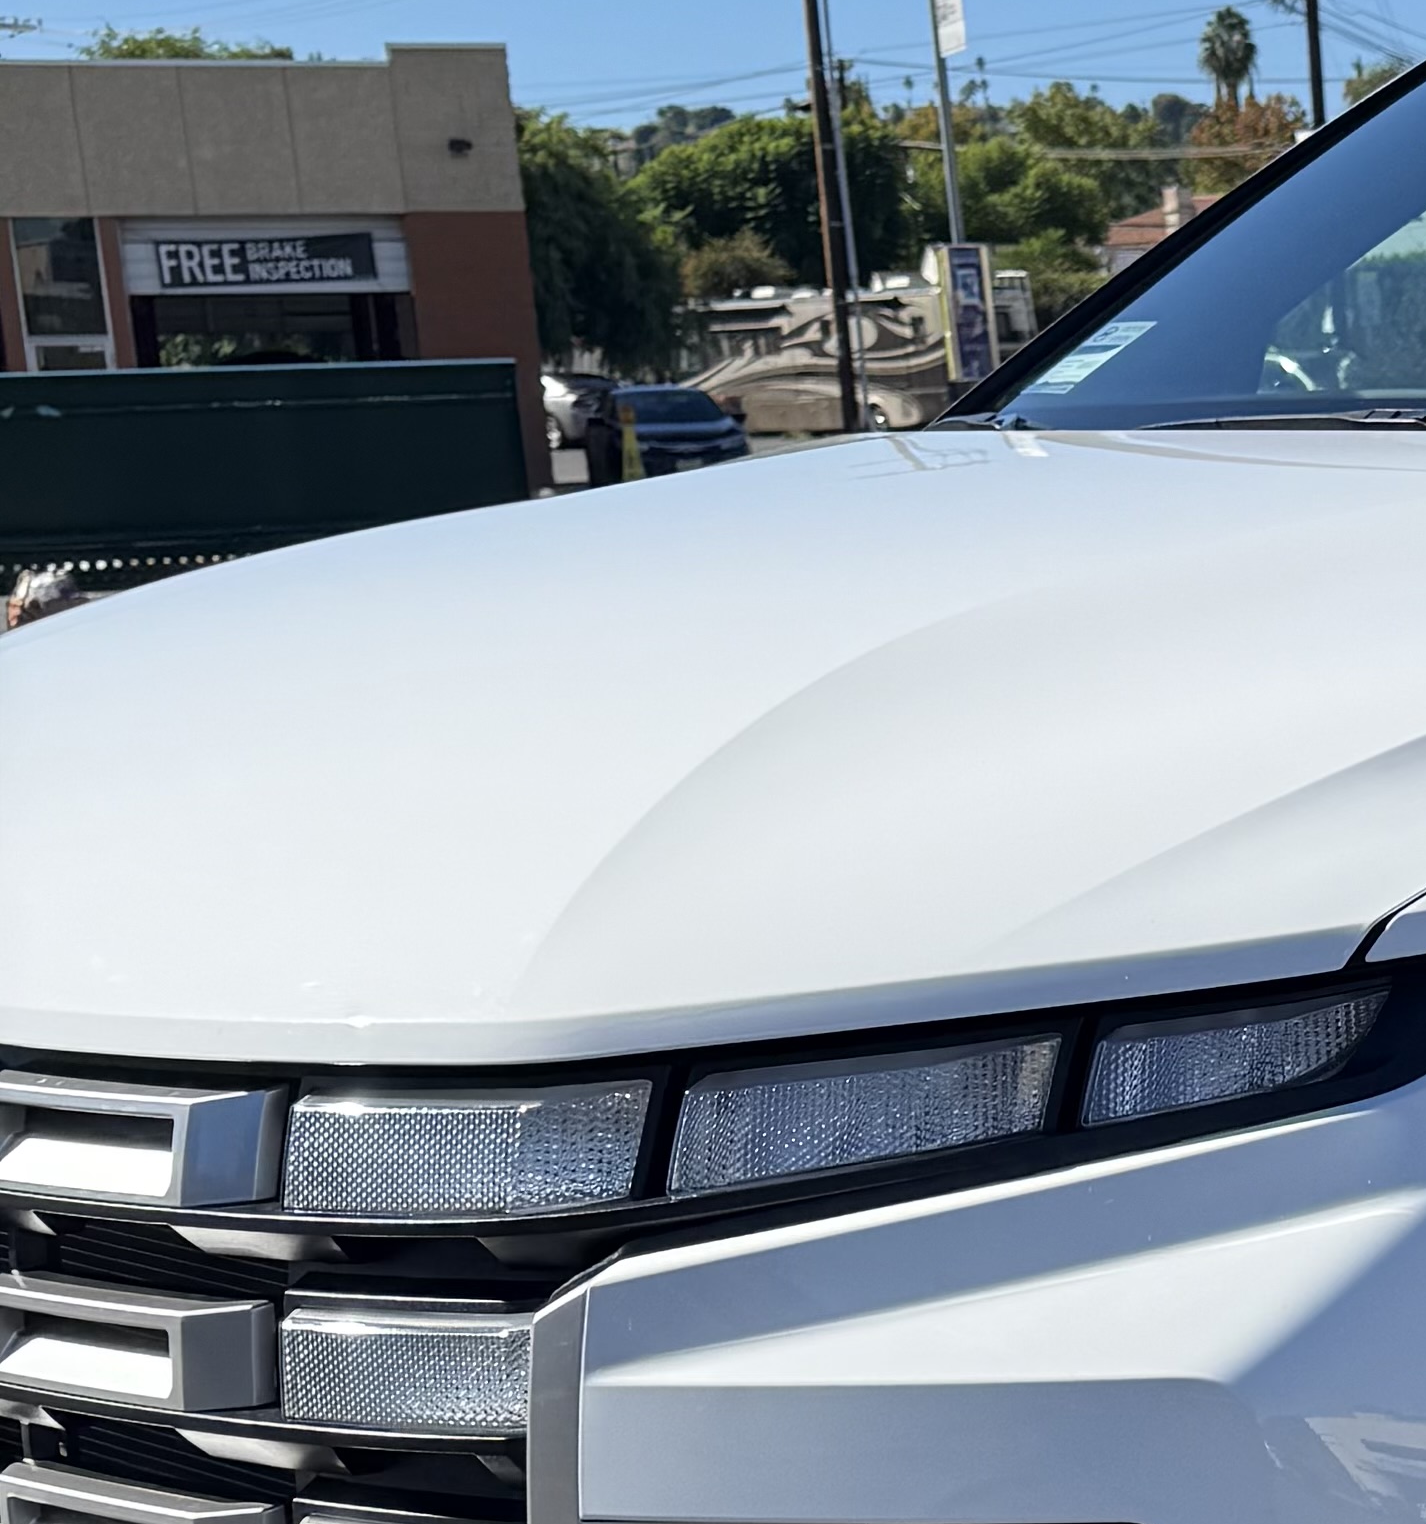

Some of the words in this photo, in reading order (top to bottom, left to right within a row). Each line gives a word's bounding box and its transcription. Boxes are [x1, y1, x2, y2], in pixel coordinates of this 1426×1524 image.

[246, 241, 308, 261] BRAKE
[158, 243, 246, 284] FREE
[248, 258, 353, 282] INSPECTION
